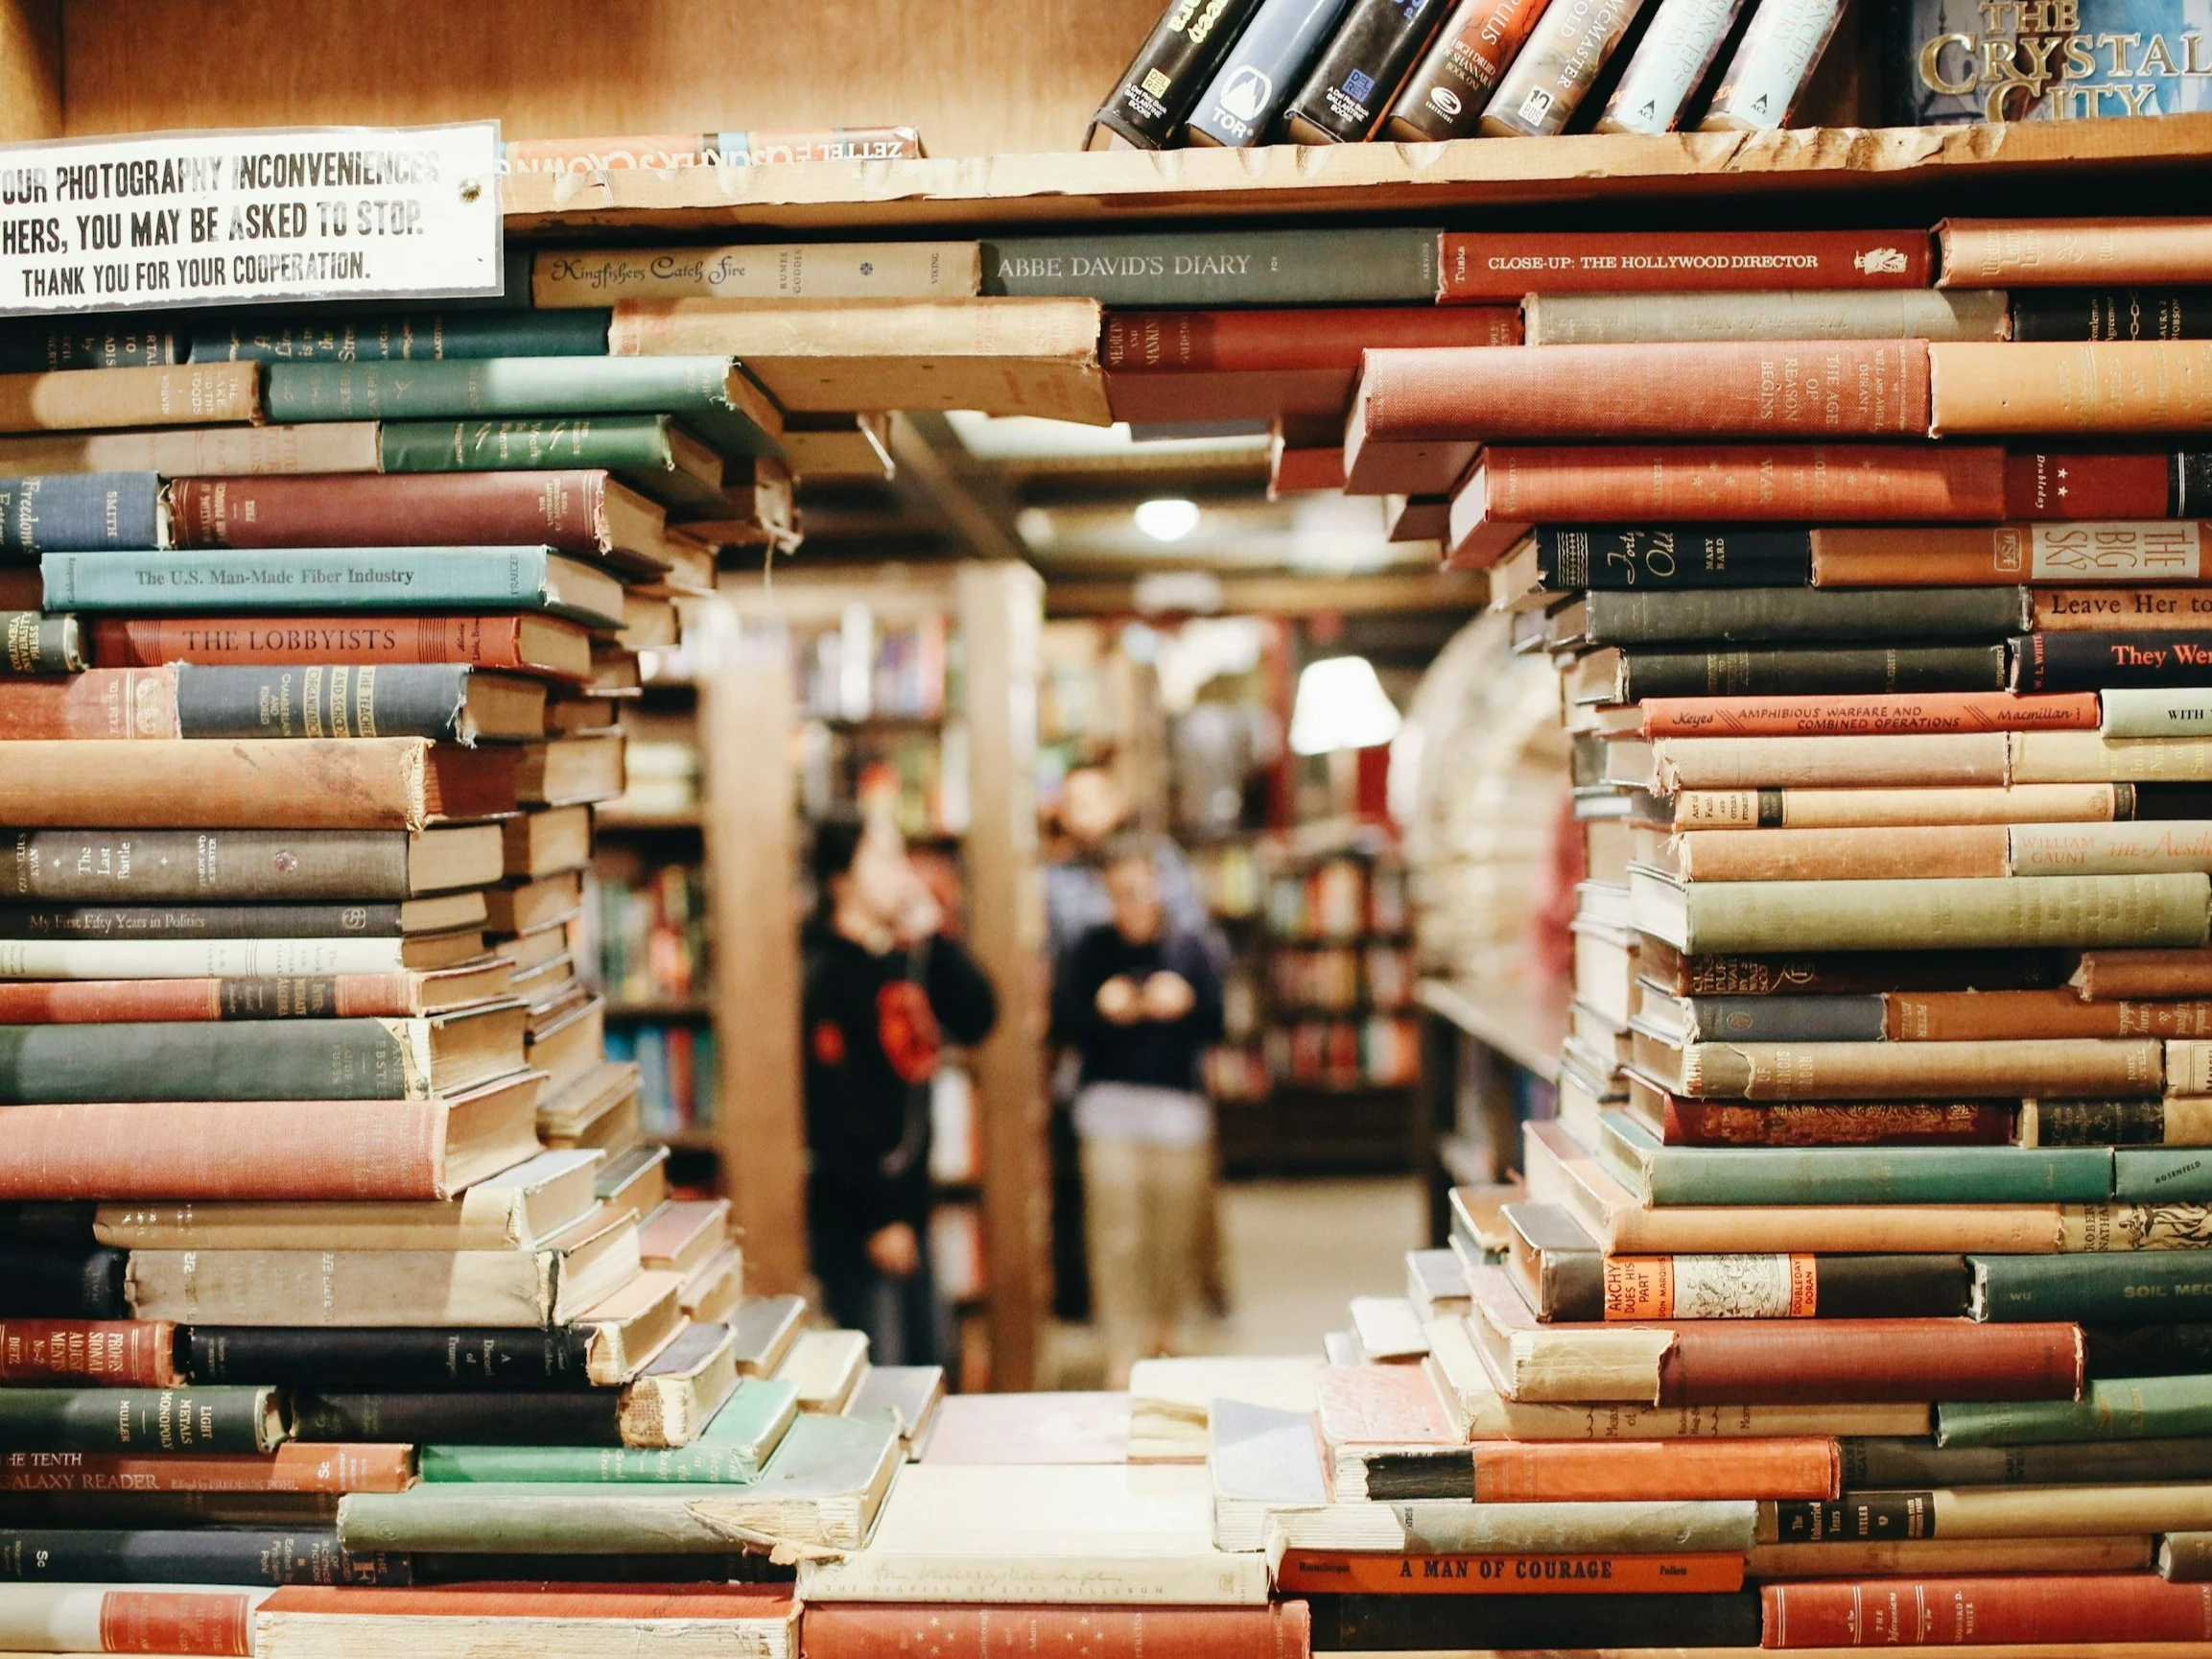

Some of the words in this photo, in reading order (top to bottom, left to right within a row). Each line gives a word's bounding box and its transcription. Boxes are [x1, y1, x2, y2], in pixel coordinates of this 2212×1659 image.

[1978, 0, 2081, 35] THE
[1918, 32, 2212, 94] CRYSTAL
[1985, 79, 2156, 123] CITY
[817, 143, 905, 161] ZETTEL
[0, 167, 48, 204] OUR
[56, 155, 224, 201] PHOTOGRAPHY
[231, 150, 441, 190] INCONVENIENCES
[0, 217, 68, 254] HERS,
[77, 212, 122, 250] YOU
[130, 208, 182, 248] MAY
[191, 206, 219, 243] BE
[228, 201, 308, 241] ASKED
[317, 201, 347, 237] TO
[356, 199, 424, 236] STOP.
[22, 266, 85, 296] THANK
[93, 262, 129, 293] YOU
[136, 260, 170, 290] FOR
[176, 256, 226, 287] YOUR
[233, 250, 371, 284] COOPERATION.
[552, 258, 647, 289] Kingfishers
[650, 255, 704, 281] Catch
[707, 255, 746, 285] Fire
[793, 248, 802, 295] GODDEN
[929, 251, 940, 287] VIKING
[999, 257, 1063, 278] ABBE
[1071, 254, 1165, 278] DAVID'S
[1174, 253, 1252, 276] DIARY
[1454, 245, 1467, 284] Tuska
[1488, 255, 1576, 271] CLOSE-UP:
[1580, 255, 1617, 270] THE
[1625, 254, 1730, 271] HOLLYWOOD
[1730, 254, 1820, 270] DIRECTOR
[1825, 353, 1841, 386] THE
[1760, 359, 1775, 420] BEGINS
[1784, 357, 1799, 422] REASON
[1805, 377, 1819, 401] OF
[1858, 363, 1870, 414] DURANT
[1825, 391, 1840, 425] AGE
[2035, 454, 2046, 510] Doubleday
[106, 490, 118, 537] SMITH
[1706, 537, 1714, 571] MARY
[1716, 537, 1725, 570] BARD
[2045, 530, 2088, 571] SKY
[2095, 531, 2137, 568] BIG
[2144, 530, 2195, 567] THE
[135, 571, 165, 585] The
[170, 571, 203, 585] U.S.
[210, 570, 294, 585] Man-Made
[301, 569, 342, 583] Fiber
[347, 569, 414, 586] Industry
[509, 554, 520, 596] PRAEGER
[2052, 595, 2121, 614] Leave
[2134, 594, 2177, 613] Her
[9, 616, 22, 671] COLUMBIA
[31, 625, 41, 660] PRESS
[182, 630, 239, 651] THE
[249, 628, 396, 651] LOBBYISTS
[2110, 645, 2167, 669] They
[335, 672, 345, 695] AND
[360, 672, 372, 690] THE
[1673, 712, 1714, 729] Keyes
[1738, 706, 1821, 720] AMPHIBIOUS
[1826, 705, 1888, 719] WARFARE
[1894, 706, 1922, 718] AND
[1798, 719, 1868, 731] COMBINED
[1874, 717, 1960, 730] OPERATIONS
[1997, 706, 2073, 722] Macmillan
[2167, 708, 2204, 722] WITH
[2022, 836, 2096, 849] WILLIAM
[2031, 851, 2087, 865] GAUNT
[30, 848, 39, 877] RYAN
[78, 846, 91, 875] The
[98, 847, 110, 876] Last
[117, 841, 130, 880] Battle
[30, 914, 50, 930] My
[55, 914, 81, 930] First
[83, 913, 112, 934] Fifty
[116, 914, 147, 930] Years
[151, 914, 161, 929] in
[164, 914, 206, 929] Politics
[2154, 1160, 2201, 1184] ROSENFELD
[1608, 1264, 1622, 1312] ARCHY
[1624, 1261, 1635, 1282] HIS
[1638, 1272, 1650, 1304] PART
[1658, 1257, 1667, 1298] MARQUIS
[1792, 1259, 1802, 1315] DOUBLEDAY
[1804, 1270, 1814, 1305] DORAN
[1624, 1287, 1635, 1314] DOES
[2123, 1285, 2168, 1298] SOIL
[1658, 1301, 1666, 1318] DON
[119, 1399, 131, 1443] MULLER
[158, 1390, 173, 1450] MONOPOLY
[178, 1398, 193, 1445] METALS
[200, 1405, 212, 1440] LIGHT
[31, 1452, 83, 1467] TENTH
[317, 1459, 332, 1480] Sc
[82, 1474, 160, 1490] READER
[267, 1479, 300, 1491] POHL
[35, 1550, 49, 1569] Sc
[1400, 1561, 1413, 1578] A
[1424, 1561, 1468, 1578] MAN
[1479, 1561, 1504, 1578] OF
[1516, 1561, 1612, 1579] COURAGE
